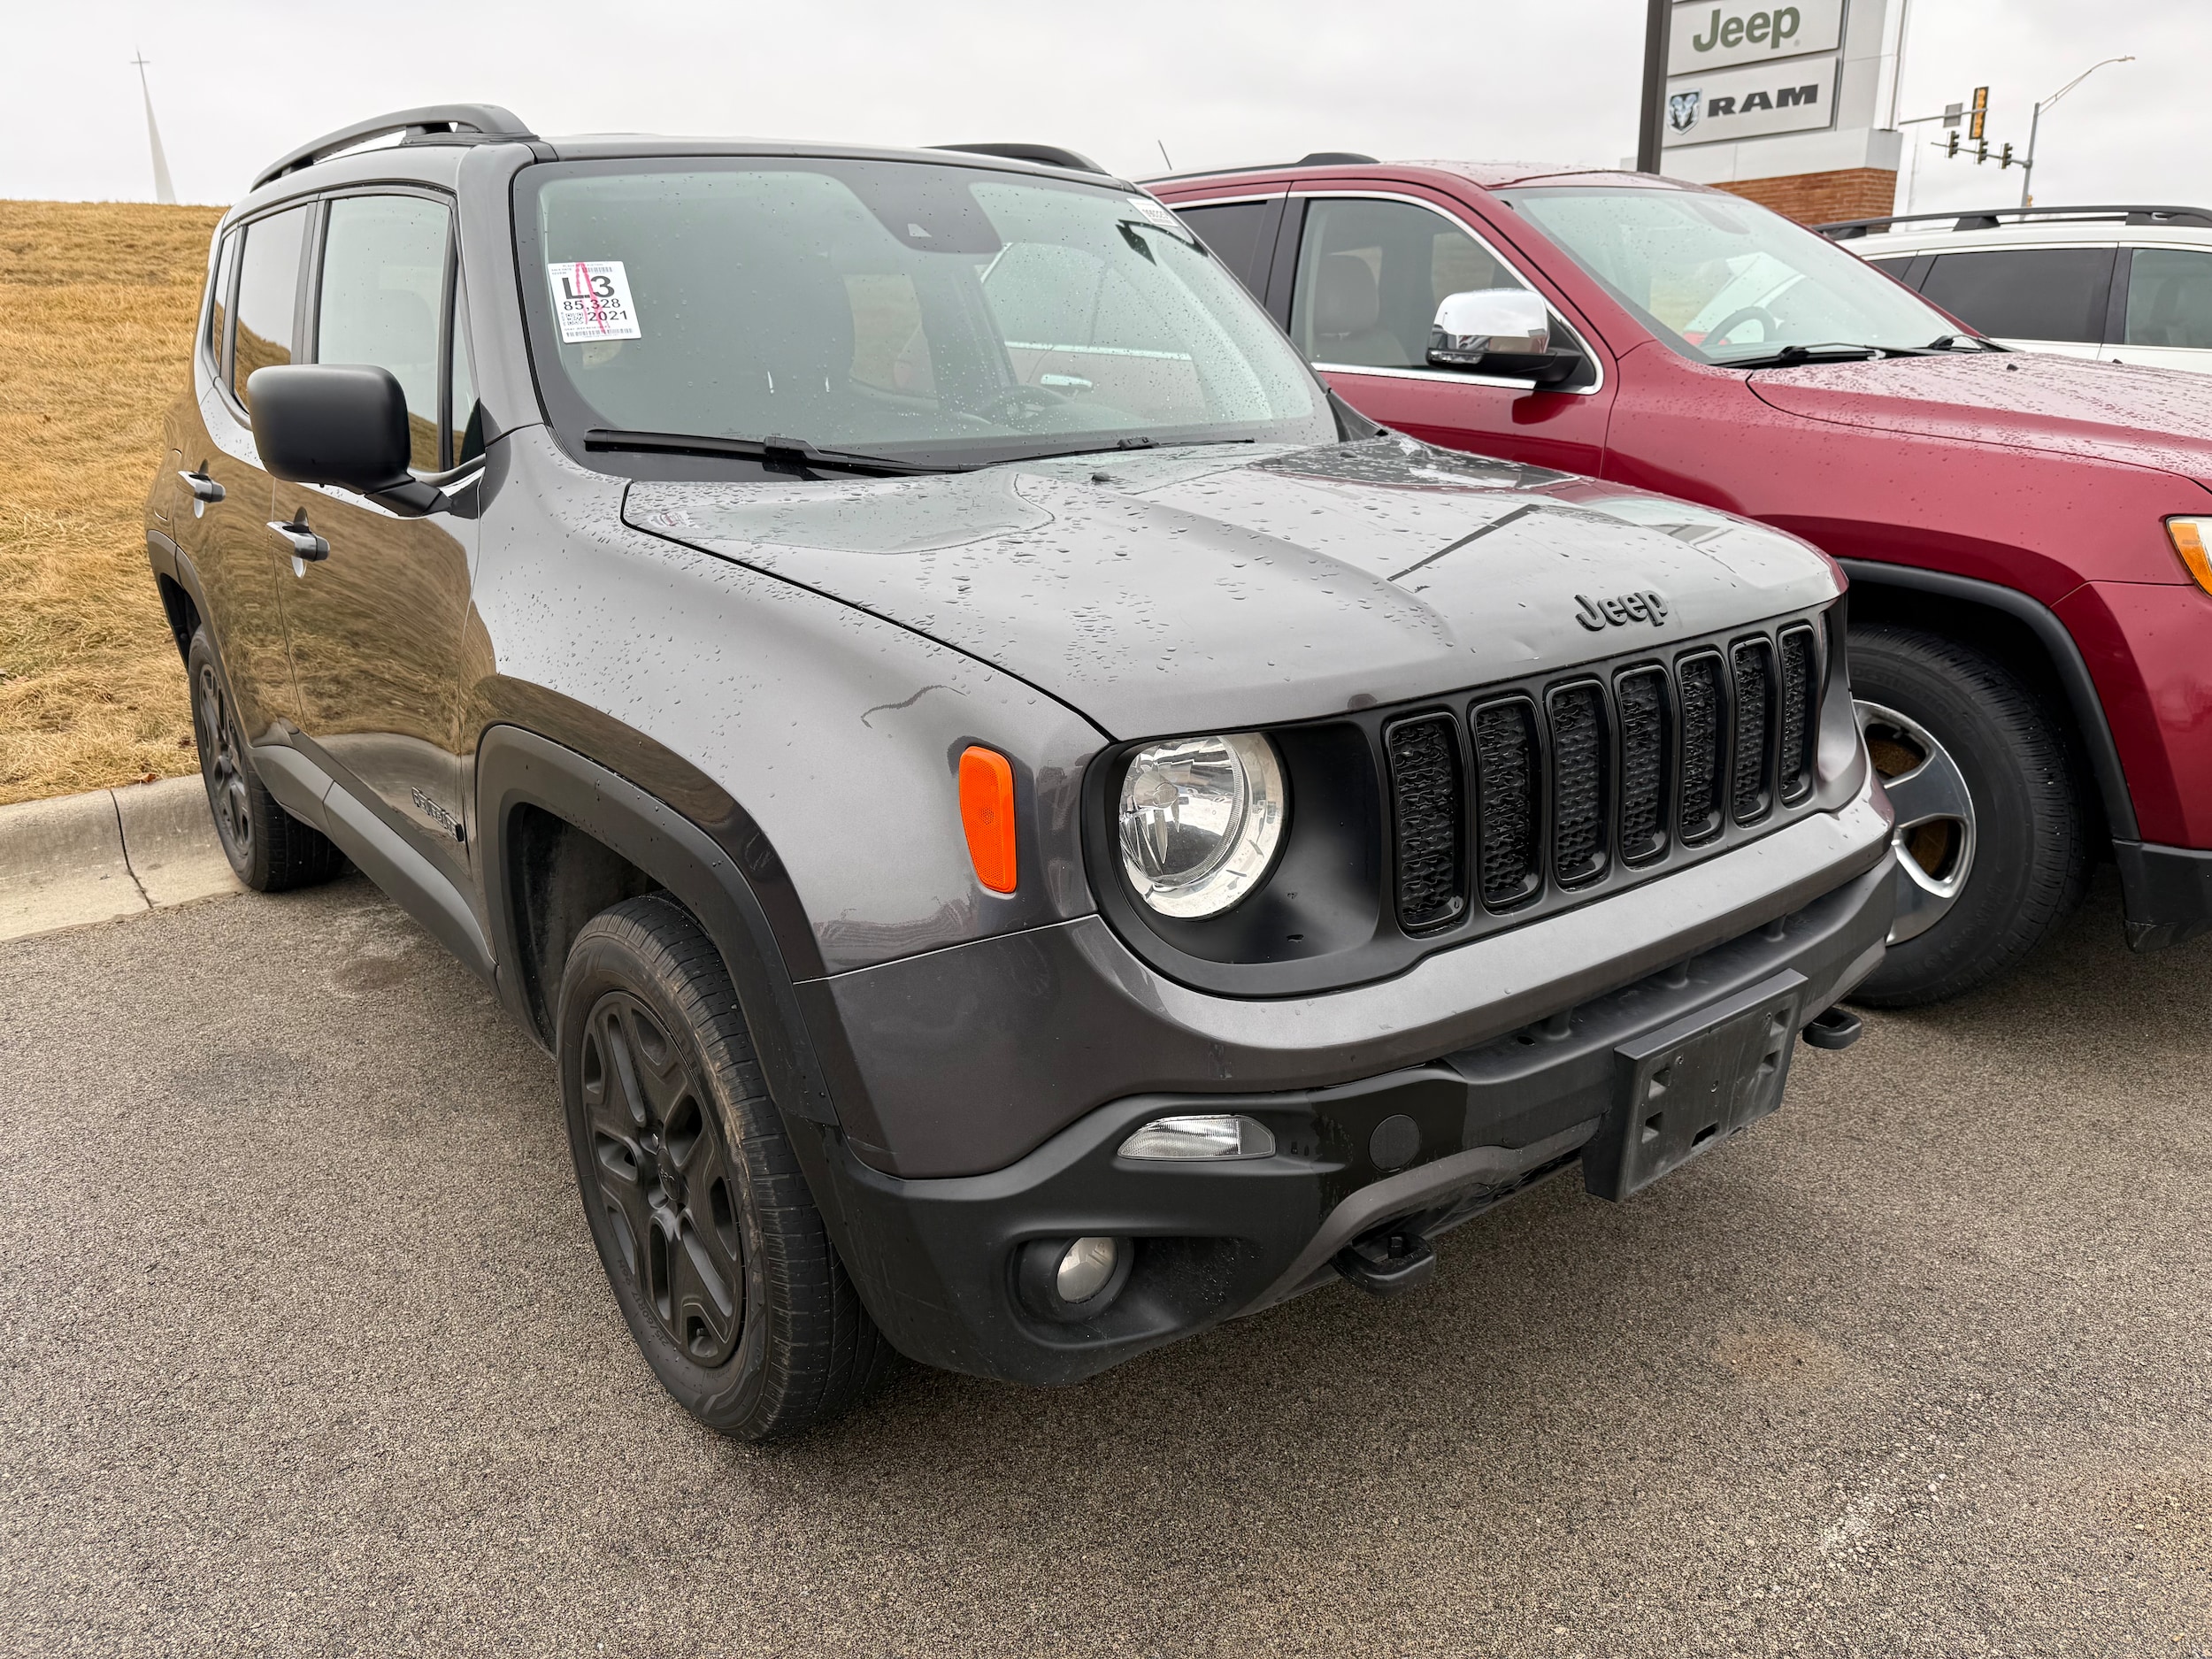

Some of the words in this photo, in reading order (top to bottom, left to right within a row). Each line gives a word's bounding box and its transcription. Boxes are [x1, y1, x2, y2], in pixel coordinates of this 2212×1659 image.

[1693, 6, 1801, 52] Jeep
[1708, 84, 1818, 118] RAM
[564, 298, 621, 311] 85,328
[588, 311, 628, 322] 2021
[1574, 590, 1668, 631] Jeep
